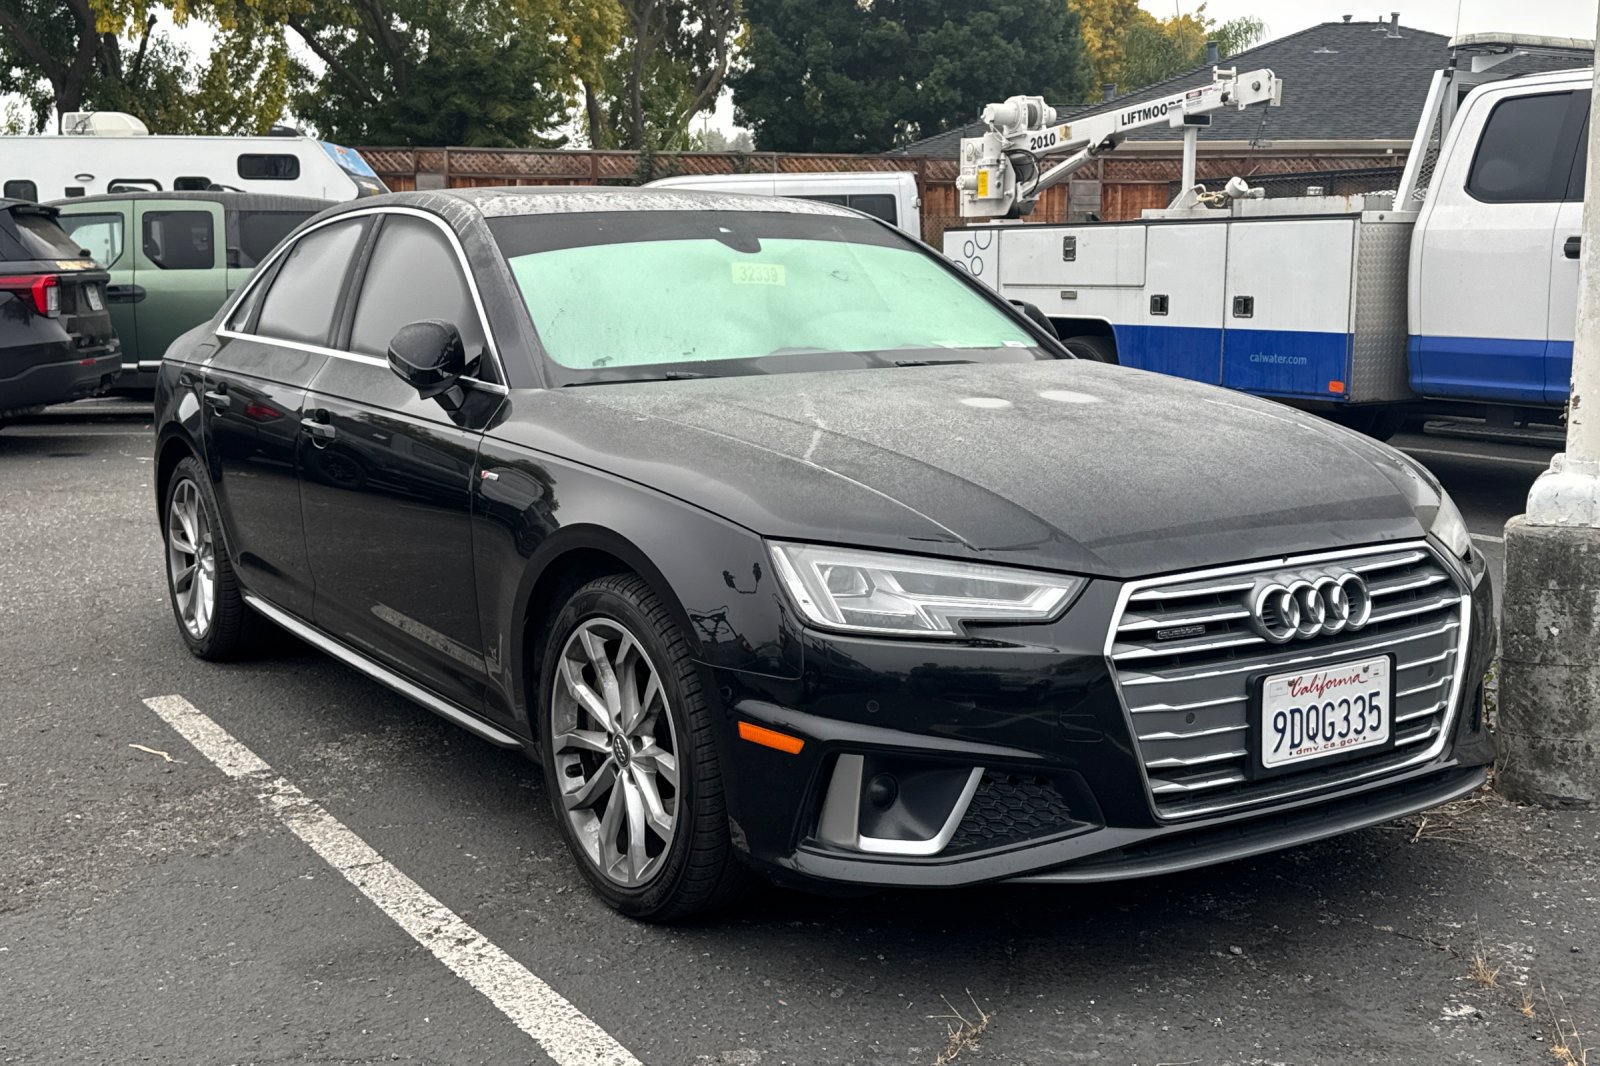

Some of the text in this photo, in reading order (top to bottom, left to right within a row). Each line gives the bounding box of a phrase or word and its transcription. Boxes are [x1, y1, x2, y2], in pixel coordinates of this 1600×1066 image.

[1121, 99, 1183, 126] LIFTMOO
[1030, 132, 1056, 150] 2010
[1249, 352, 1307, 365] calwater.com
[1290, 670, 1368, 698] California
[1273, 691, 1382, 753] 9DQG335
[1296, 736, 1360, 755] dmv.ca.gov
